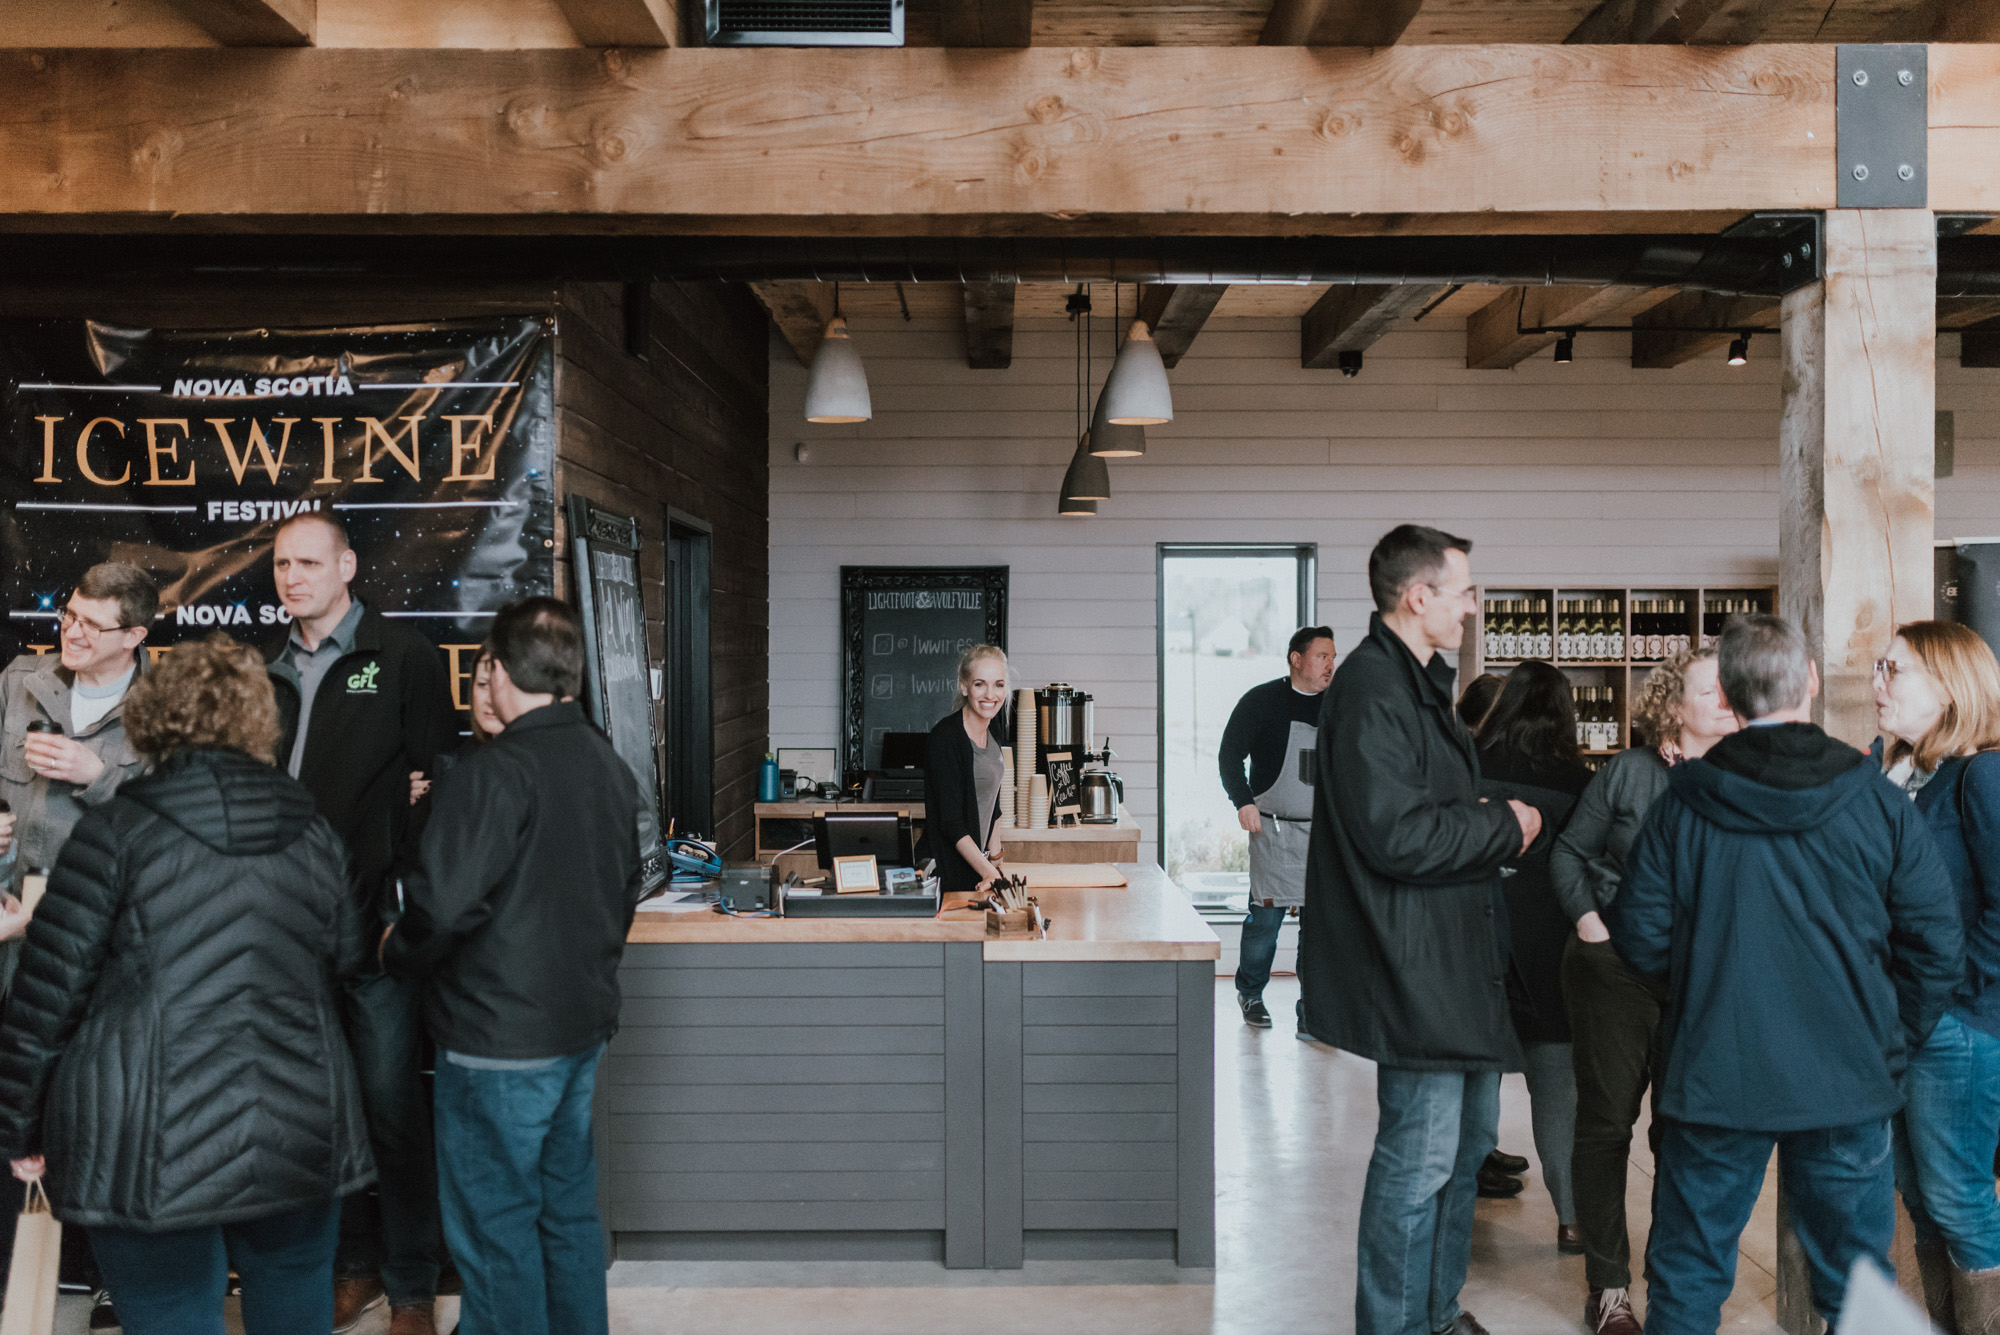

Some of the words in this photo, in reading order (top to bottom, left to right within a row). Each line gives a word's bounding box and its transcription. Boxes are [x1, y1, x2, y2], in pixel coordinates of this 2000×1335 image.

[172, 379, 247, 397] NOVA
[254, 376, 354, 397] SCOTIA
[33, 414, 496, 486] ICEWINE
[868, 591, 917, 610] LIGHTFOOT
[931, 591, 982, 610] WOLFVILLE
[176, 605, 252, 625] NOVA
[347, 668, 379, 689] GFL
